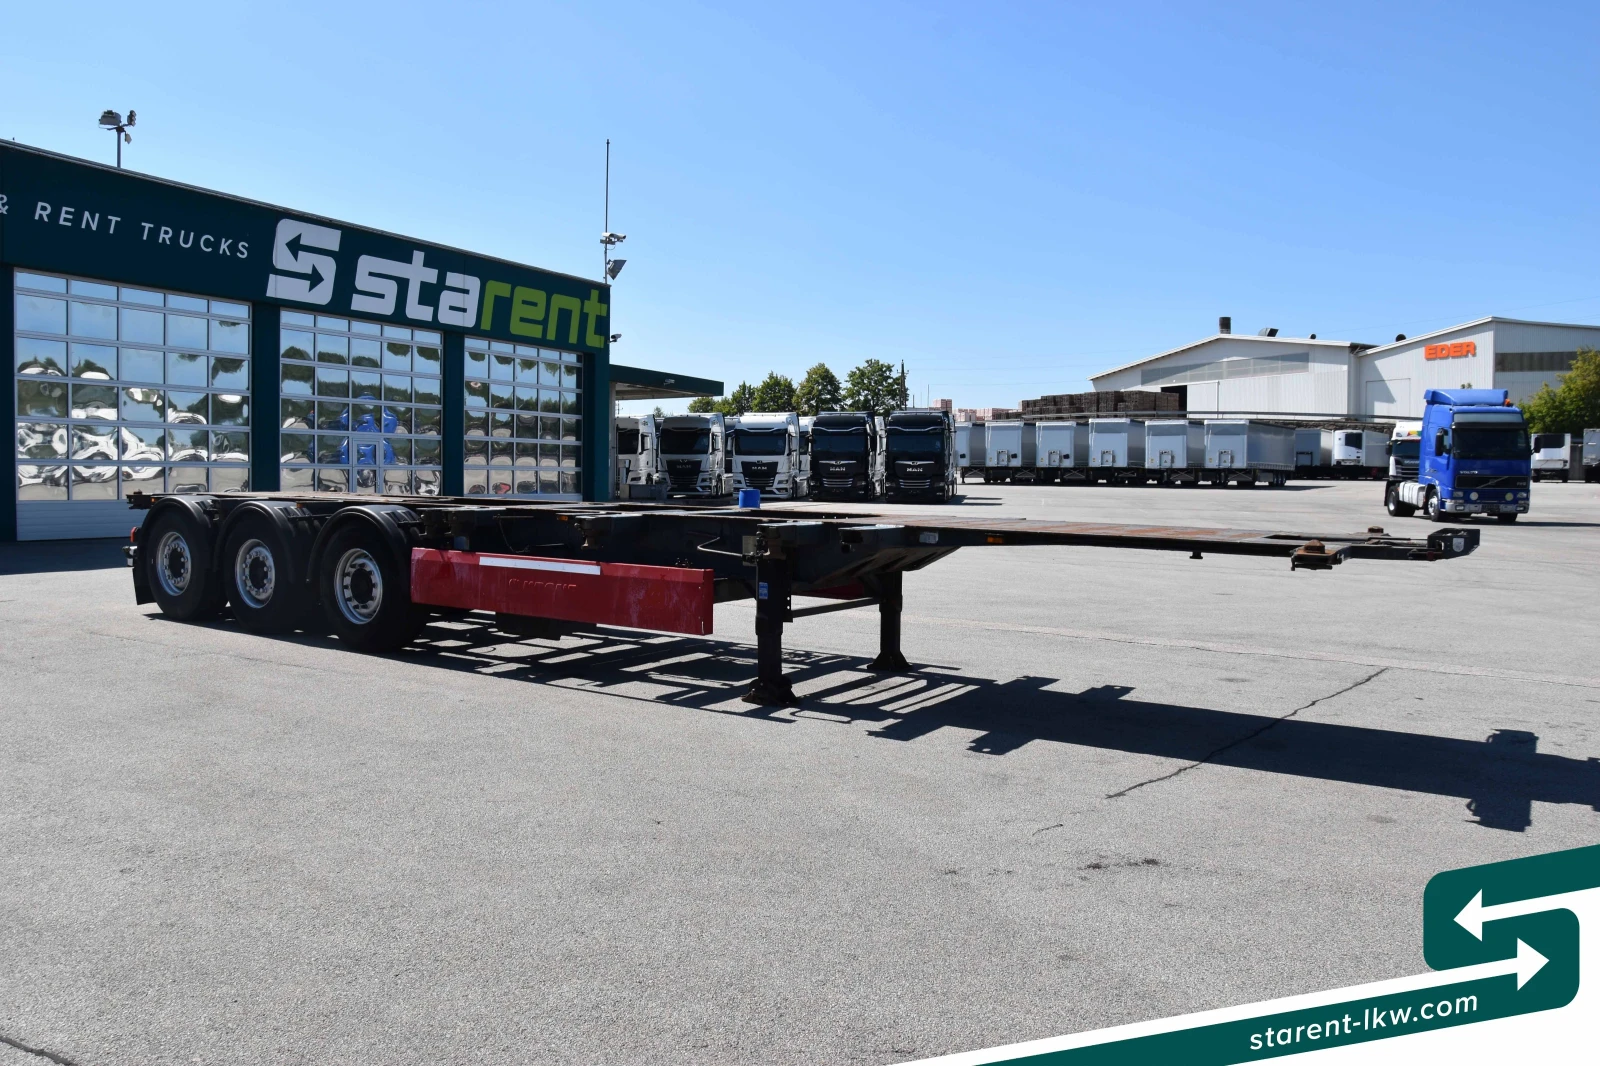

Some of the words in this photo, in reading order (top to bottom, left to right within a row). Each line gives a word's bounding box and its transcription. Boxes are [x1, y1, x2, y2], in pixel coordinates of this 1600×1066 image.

[34, 201, 121, 234] RENT
[141, 222, 249, 259] TRUCKS
[350, 249, 608, 349] starent
[1425, 341, 1476, 360] EDER
